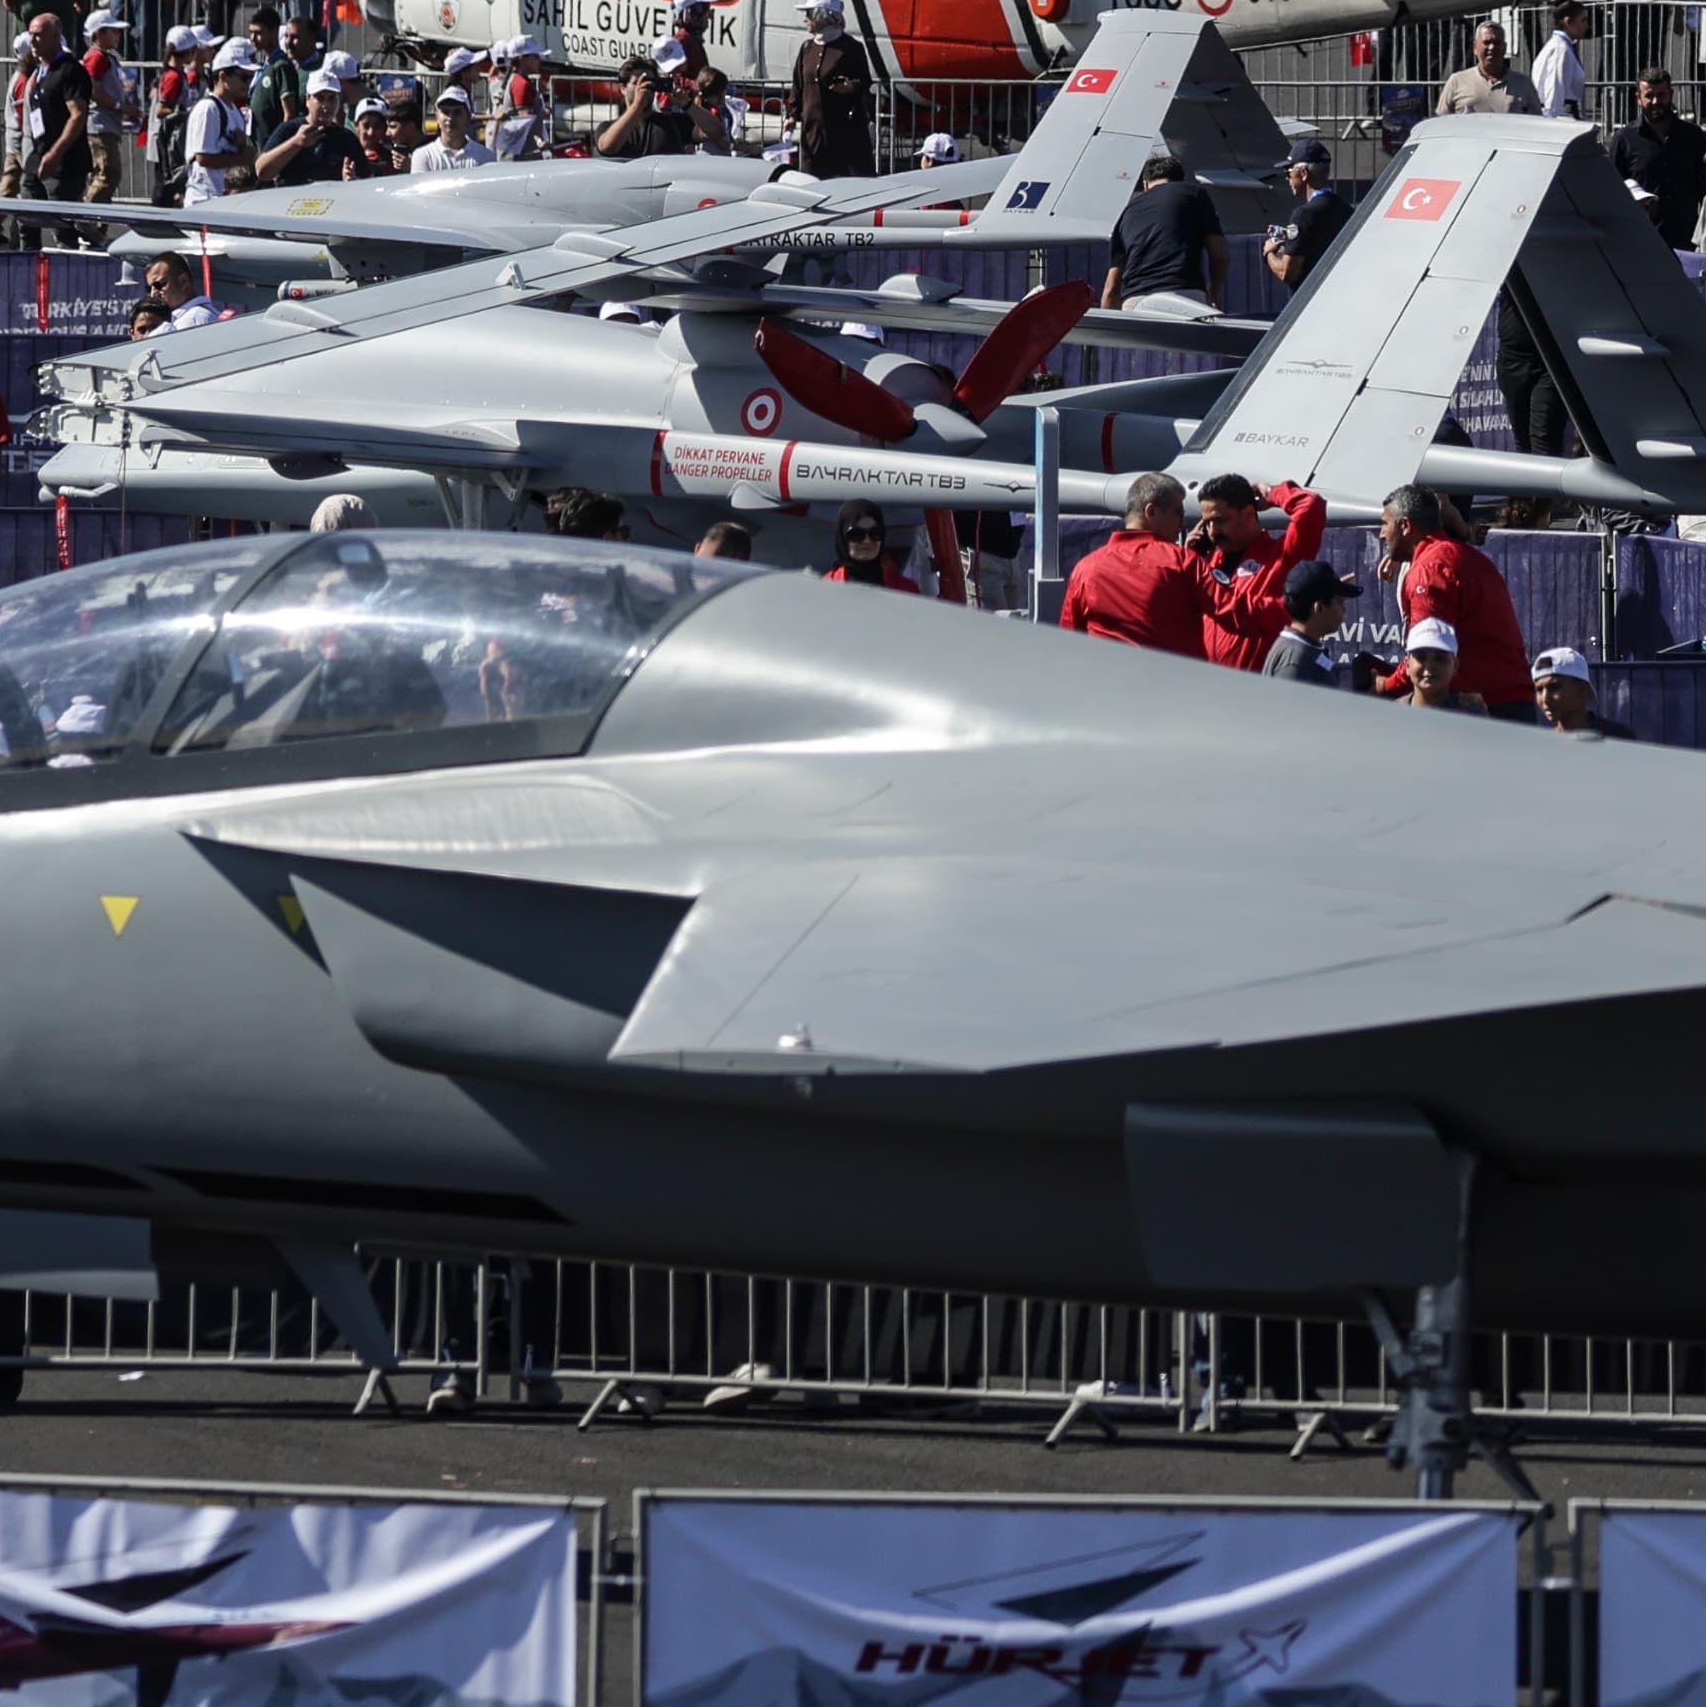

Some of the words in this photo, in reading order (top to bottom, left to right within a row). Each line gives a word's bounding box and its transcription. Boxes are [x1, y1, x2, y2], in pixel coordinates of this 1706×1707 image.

[562, 32, 606, 57] COAST
[845, 232, 875, 247] TB2
[1245, 432, 1310, 448] BAYKAR
[674, 444, 713, 462] DİKKAT
[714, 449, 766, 466] PERVANE
[664, 461, 708, 478] DANGER
[709, 465, 772, 483] PROPELLER
[796, 463, 923, 488] BAYRAKTAR
[927, 472, 966, 490] TB3
